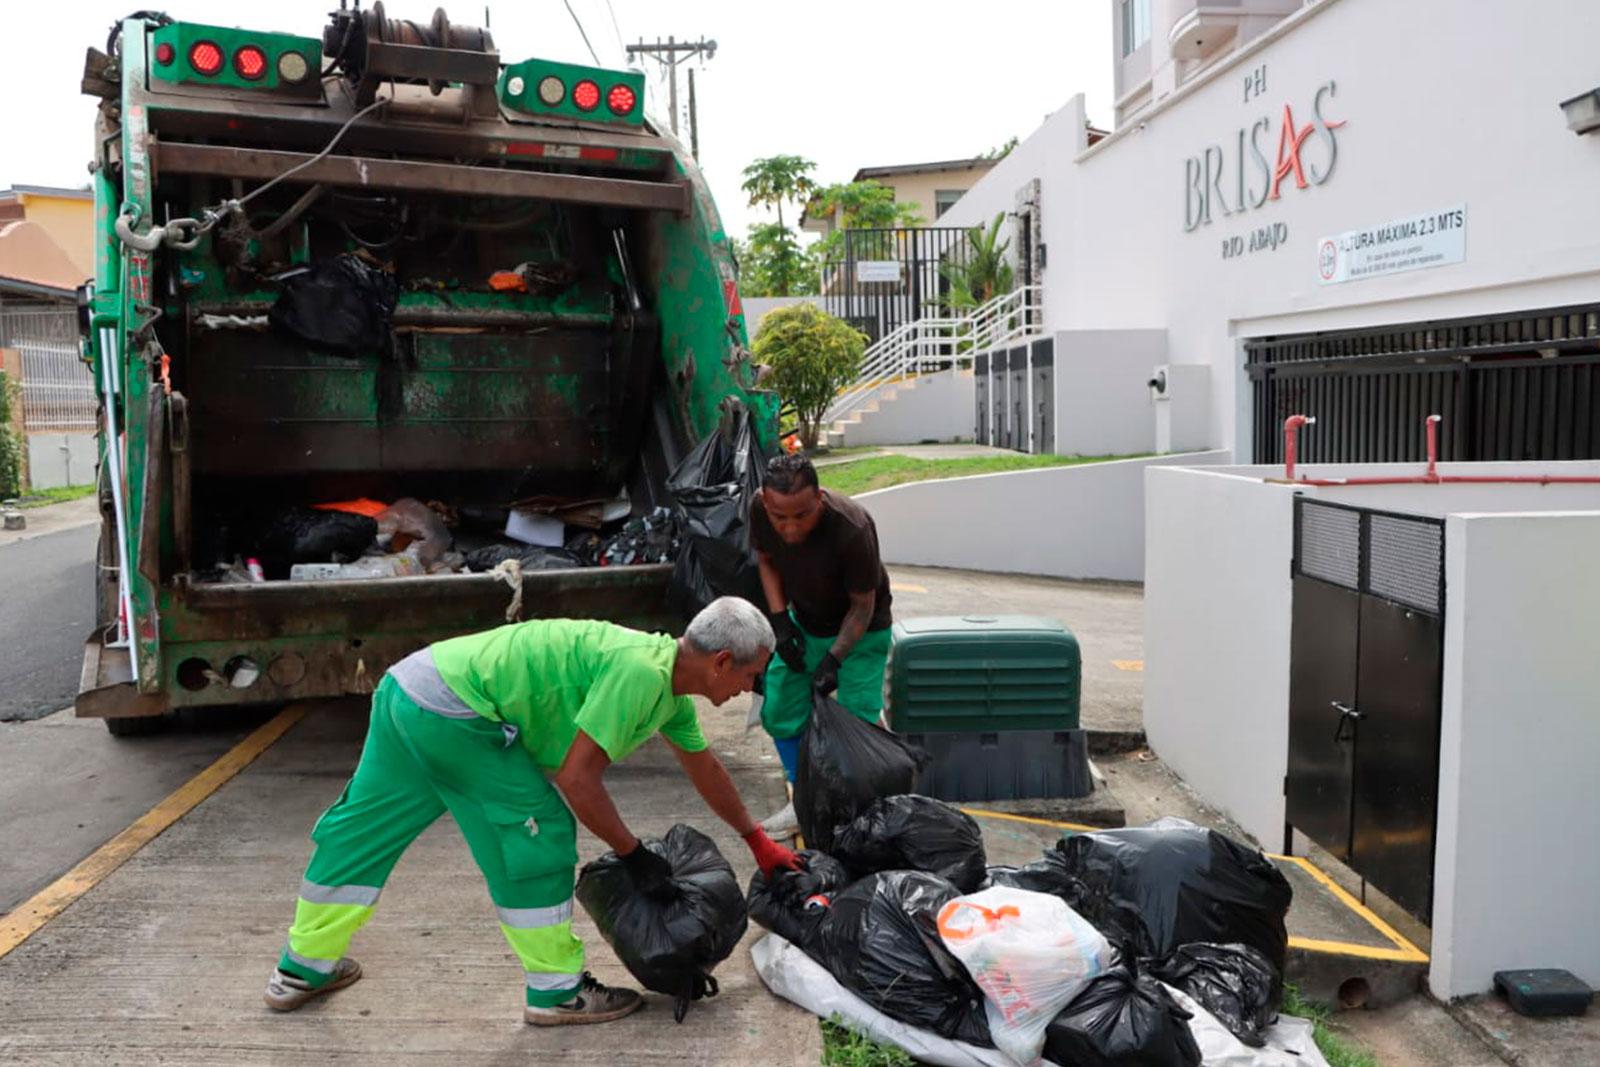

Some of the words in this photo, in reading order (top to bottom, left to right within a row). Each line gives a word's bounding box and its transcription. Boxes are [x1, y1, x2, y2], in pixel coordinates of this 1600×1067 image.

[1243, 64, 1267, 103] PH
[1184, 79, 1347, 233] BRISAS
[1249, 222, 1288, 252] ABAJO
[1438, 209, 1463, 231] MTS
